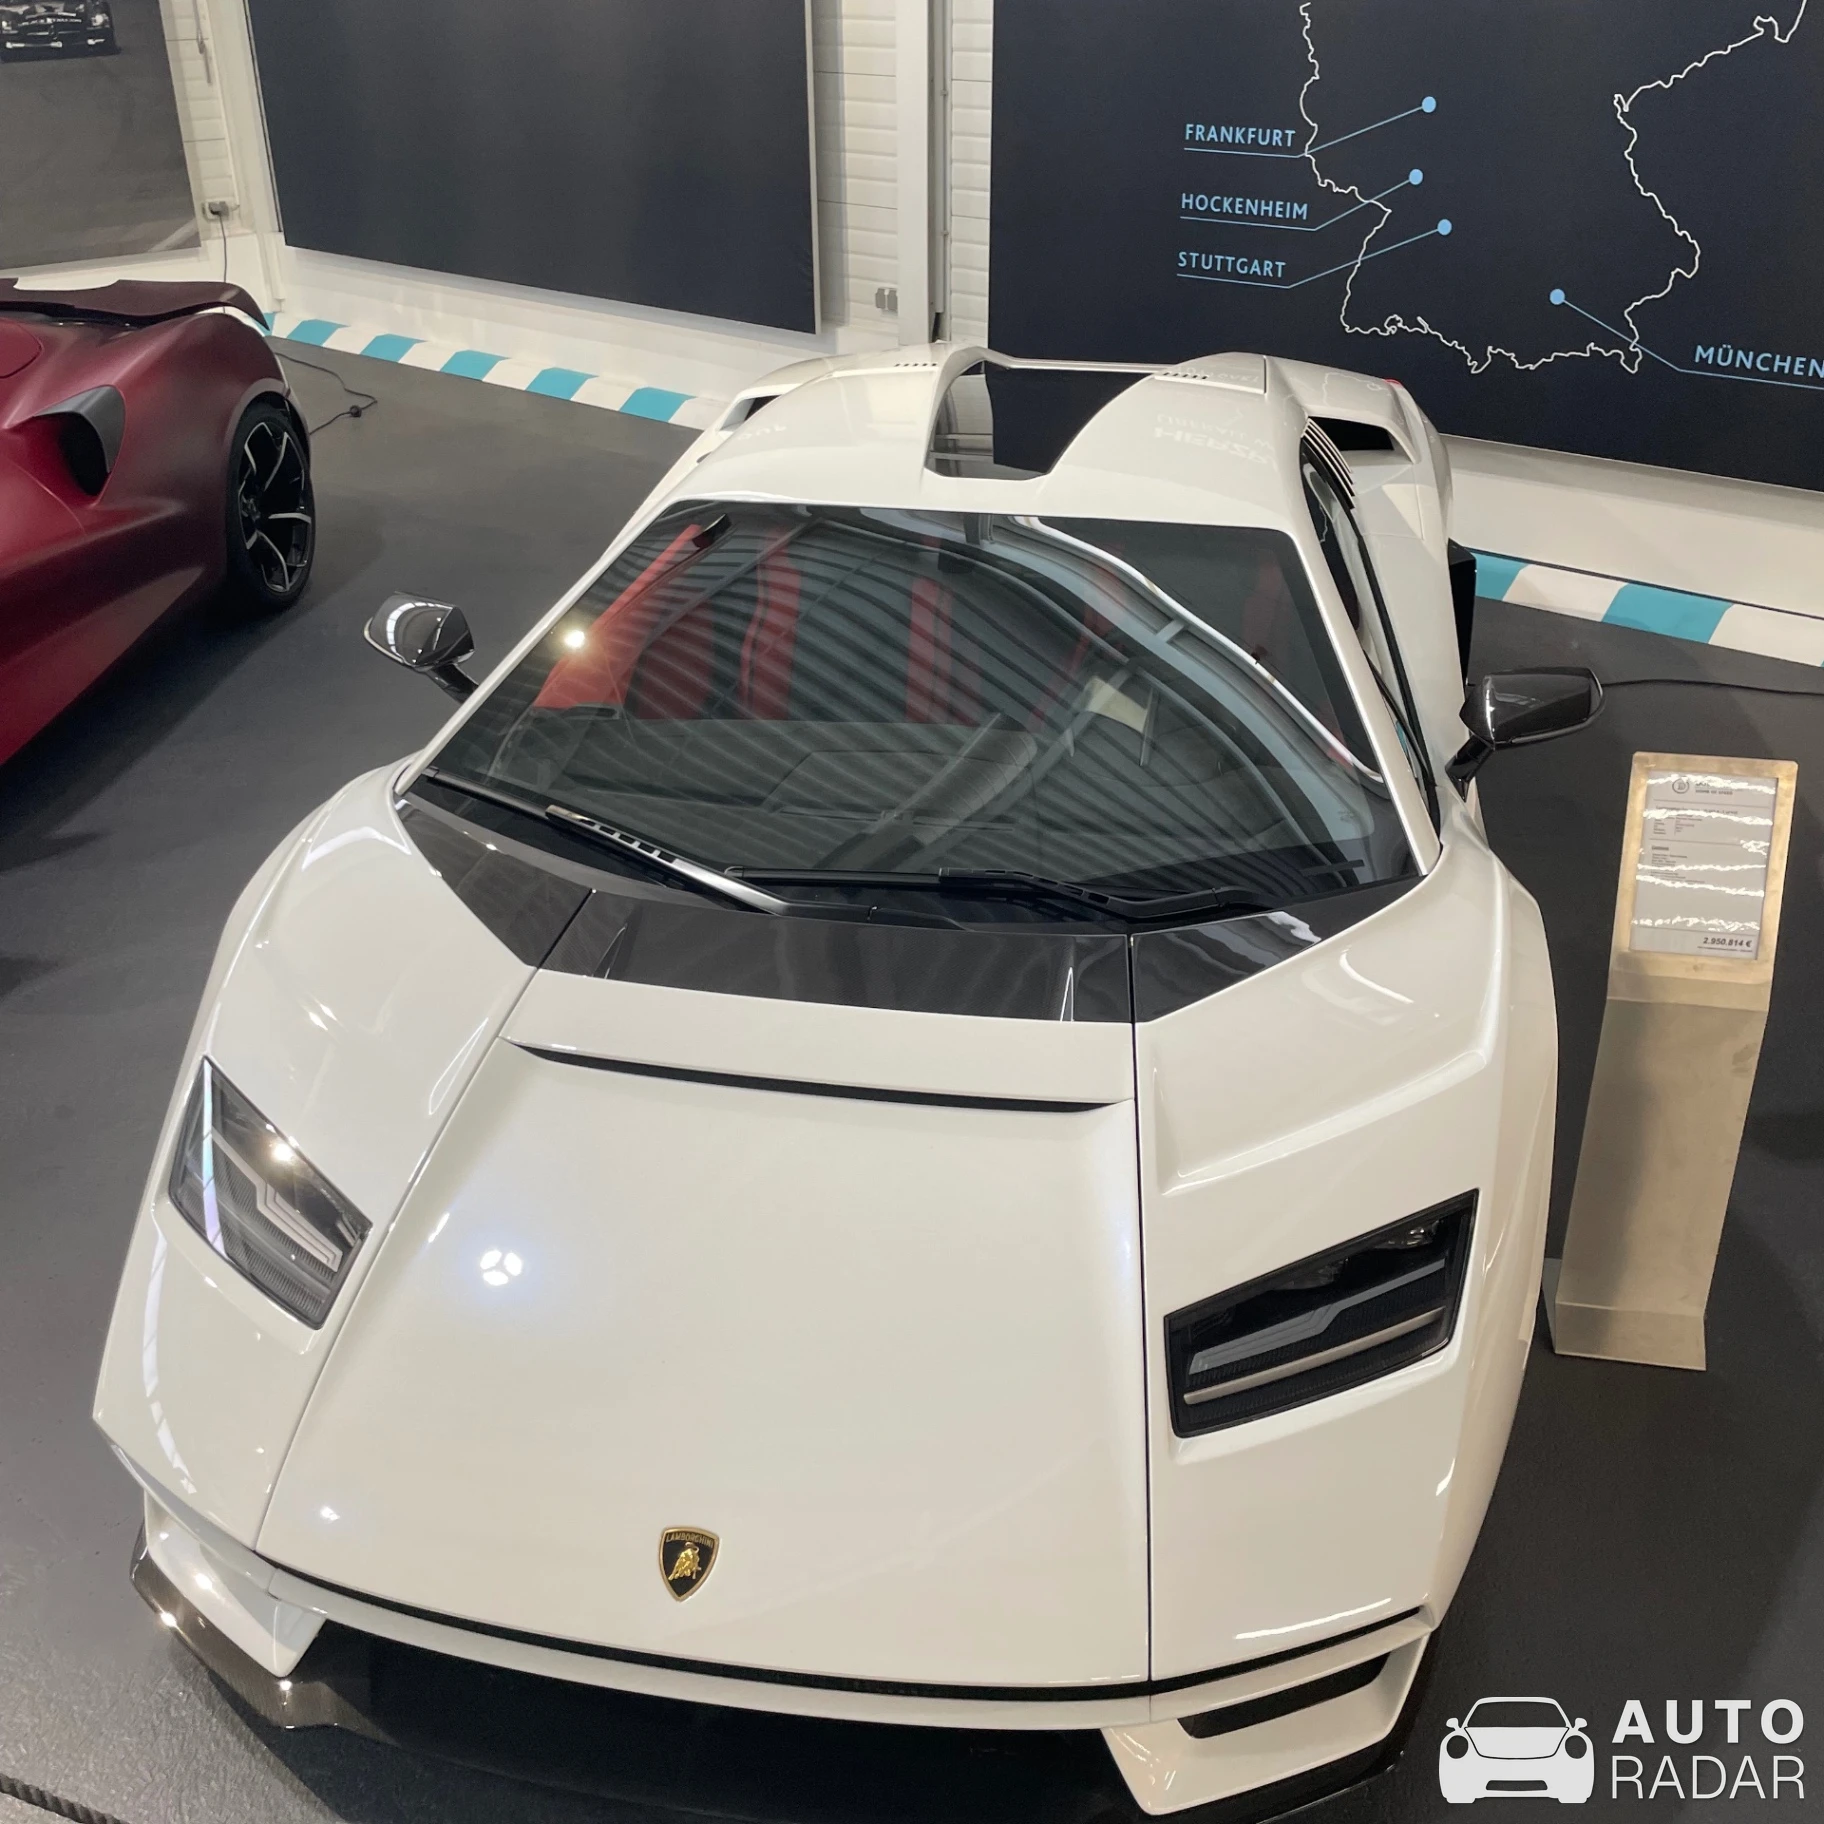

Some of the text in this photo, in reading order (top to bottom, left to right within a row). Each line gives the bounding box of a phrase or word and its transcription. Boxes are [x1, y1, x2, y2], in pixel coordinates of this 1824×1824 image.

[1185, 123, 1296, 147] FRANKFURT
[1181, 193, 1308, 220] HOCKENHEIM
[1177, 251, 1287, 278] STUTTGART
[1694, 344, 1824, 378] MÜNCHEN
[666, 1532, 714, 1548] LAMBORGHINI
